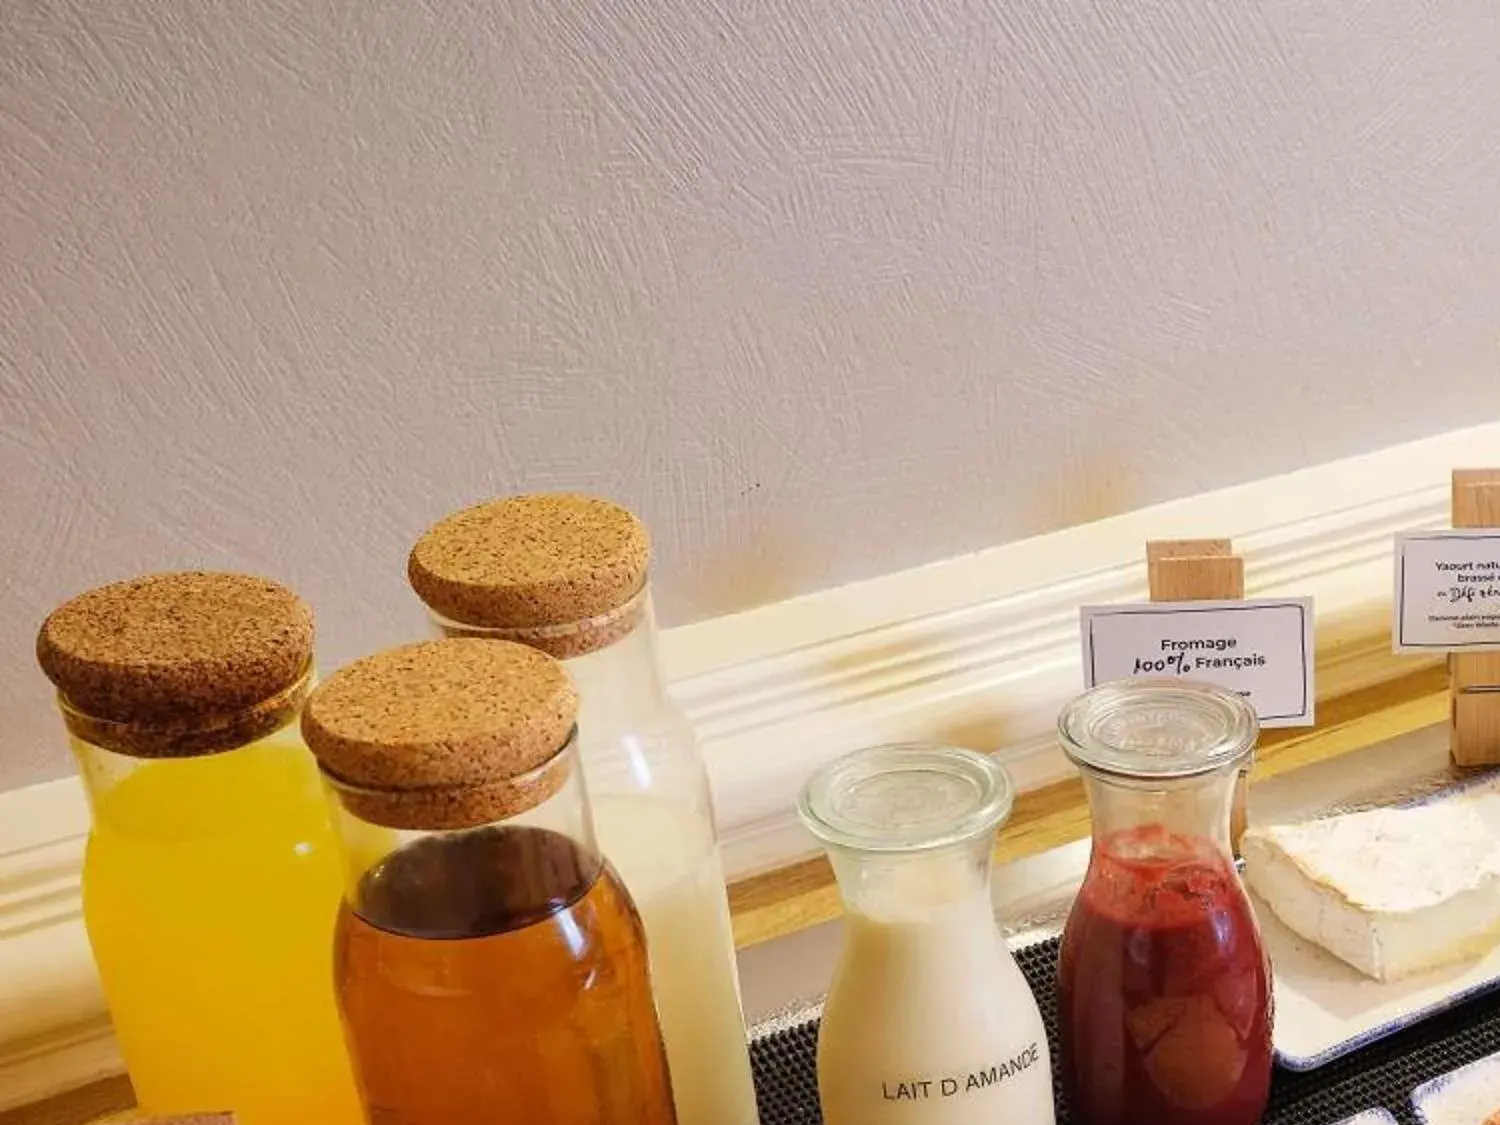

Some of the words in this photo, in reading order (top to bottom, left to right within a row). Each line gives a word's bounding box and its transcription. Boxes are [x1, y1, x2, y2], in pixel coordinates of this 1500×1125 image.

[1435, 561, 1473, 571] Yaourt
[1457, 572, 1495, 582] brassé
[1161, 637, 1237, 652] Fromage
[1133, 652, 1191, 674] 100%
[1195, 653, 1266, 671] Français
[882, 1080, 932, 1100] LAIT
[965, 1042, 1039, 1092] AMANDE
